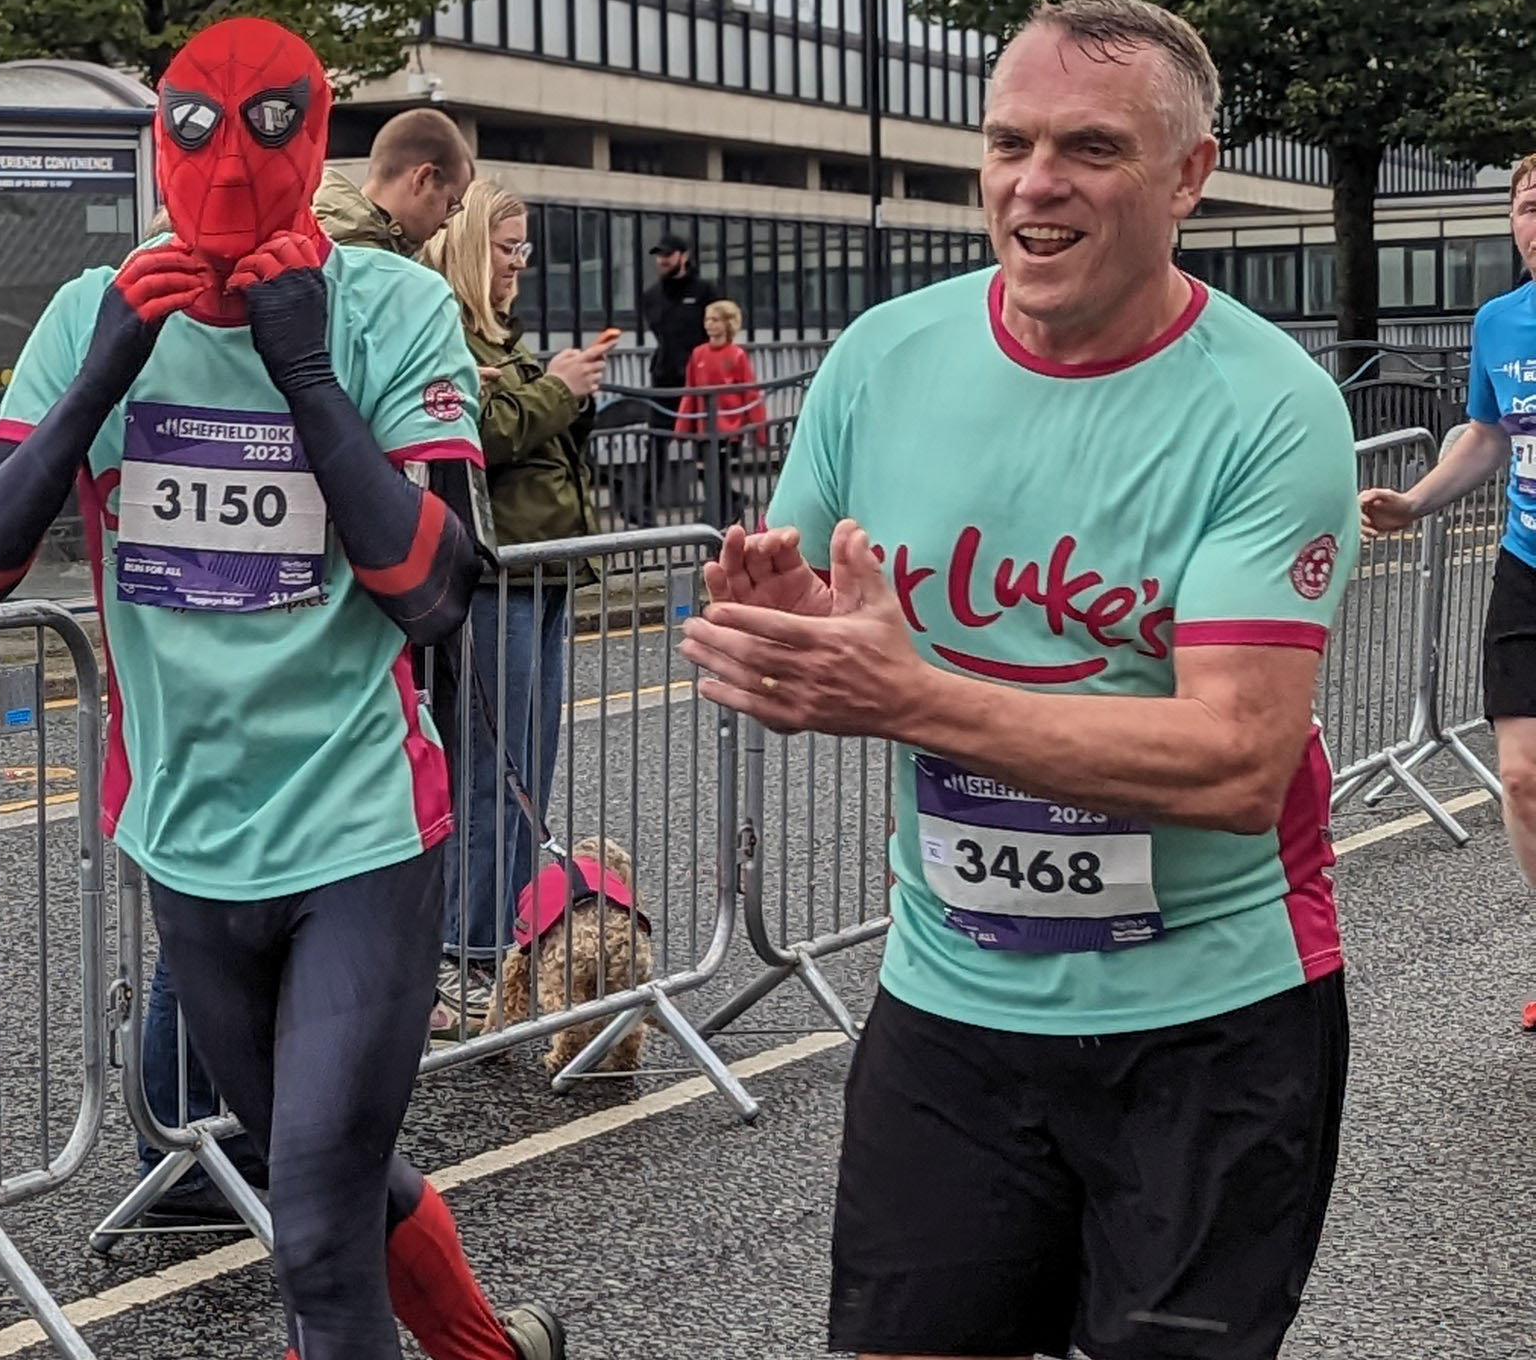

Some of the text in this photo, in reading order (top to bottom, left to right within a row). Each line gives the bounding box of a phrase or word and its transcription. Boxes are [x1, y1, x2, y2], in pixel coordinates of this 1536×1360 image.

[44, 156, 114, 171] CONVENIENCE
[180, 421, 292, 442] SHEFFIELD 10K
[243, 444, 293, 462] 2023
[152, 478, 287, 528] 3150
[949, 526, 1175, 659] Luke's
[954, 839, 1105, 895] 3468
